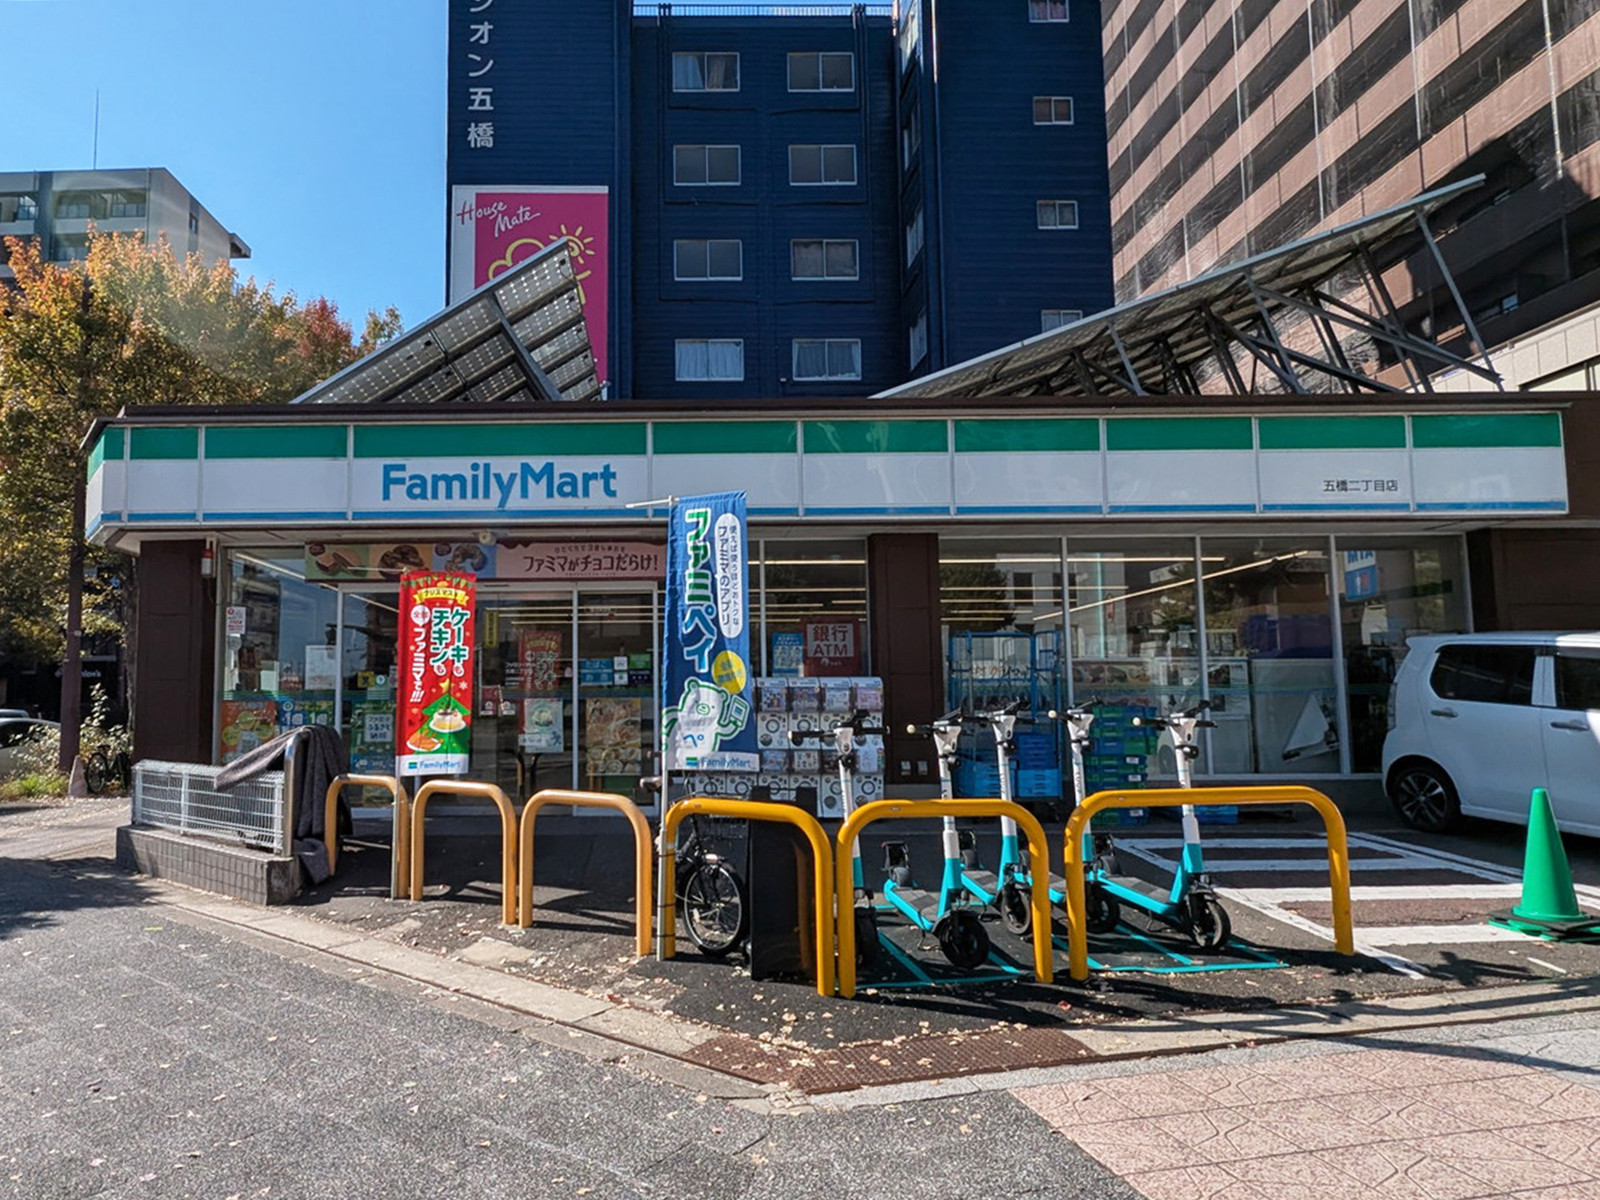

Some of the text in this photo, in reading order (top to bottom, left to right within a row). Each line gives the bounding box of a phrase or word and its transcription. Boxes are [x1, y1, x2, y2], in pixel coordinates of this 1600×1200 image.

[456, 200, 507, 225] House
[494, 206, 541, 238] Mate
[382, 462, 617, 510] FamilyMart
[1323, 480, 1398, 492] 五橋二丁目店
[523, 554, 659, 573] ファミマがチョコだらけ!
[718, 526, 731, 626] ファミマのアプリ
[683, 508, 717, 672] ファミペイ
[430, 608, 450, 675] チキンも
[452, 607, 470, 676] ケーキも
[813, 626, 848, 642] 銀行
[813, 644, 848, 656] ATM
[420, 760, 460, 769] FamilyMart
[701, 757, 751, 768] FamilyMart
